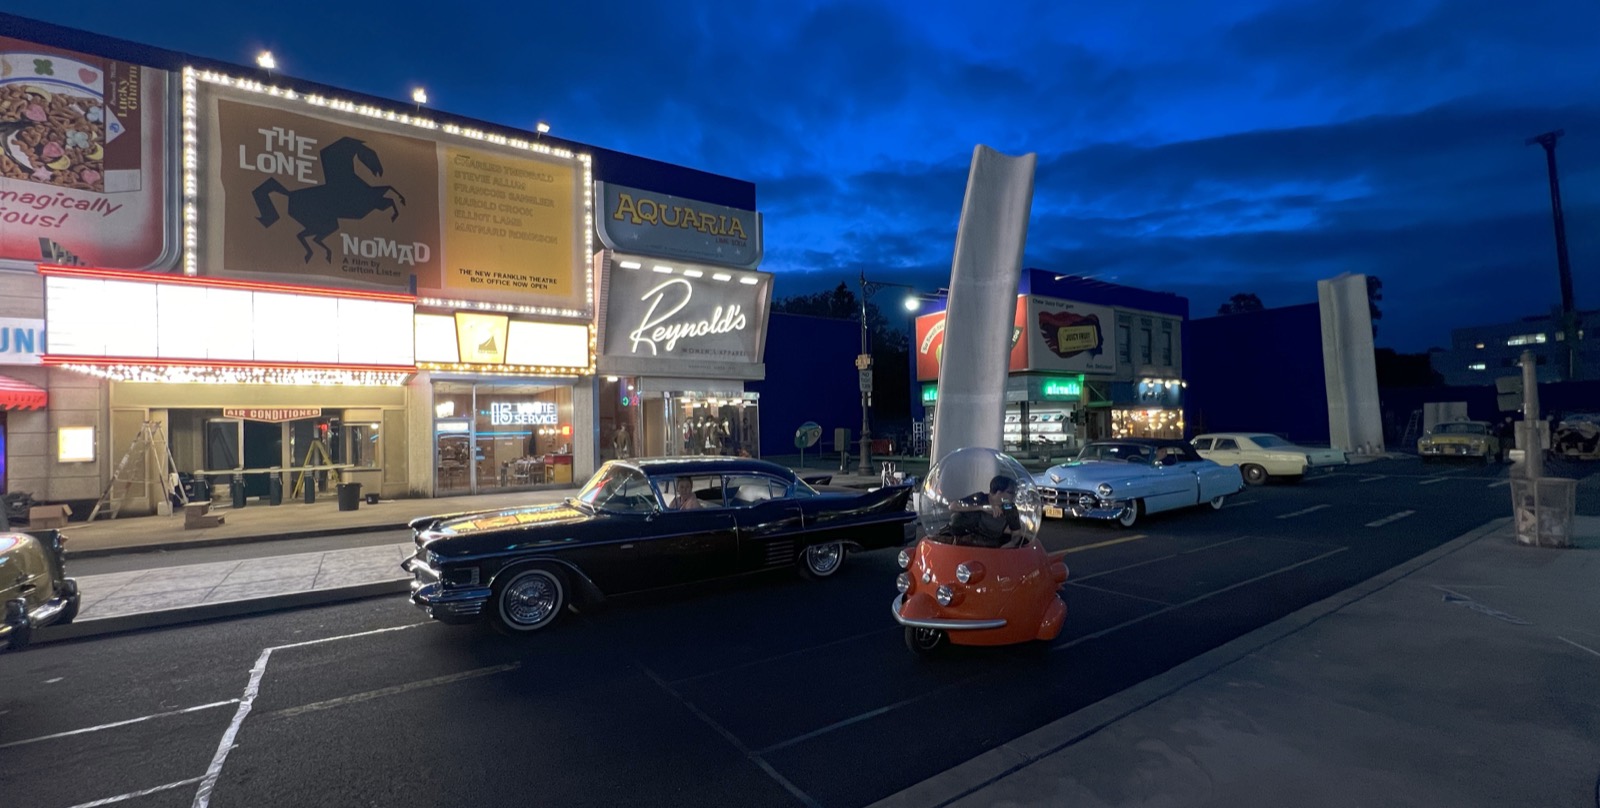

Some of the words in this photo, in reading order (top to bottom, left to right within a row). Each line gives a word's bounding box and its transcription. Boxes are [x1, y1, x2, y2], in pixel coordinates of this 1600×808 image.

[118, 80, 130, 117] Lucky
[258, 126, 318, 160] THE
[240, 144, 318, 184] LONE
[454, 156, 502, 174] CHARLES
[454, 170, 490, 184] STEVIE
[454, 196, 497, 210] HAROLD
[454, 210, 490, 223] ELLIOT
[613, 192, 748, 239] AQUARIA
[455, 222, 507, 237] MAYNARD
[509, 230, 558, 244] ROBINSON
[340, 233, 430, 266] NOMAD
[341, 265, 374, 274] Carlton
[352, 258, 368, 266] film
[371, 260, 380, 268] by
[486, 278, 510, 286] OFFICE
[493, 272, 527, 281] FRANKLIN
[529, 276, 557, 284] THEATRE
[629, 278, 746, 356] Reynold's
[250, 409, 318, 420] CONDITIONED
[491, 402, 512, 425] 15
[514, 414, 558, 424] SERVICE
